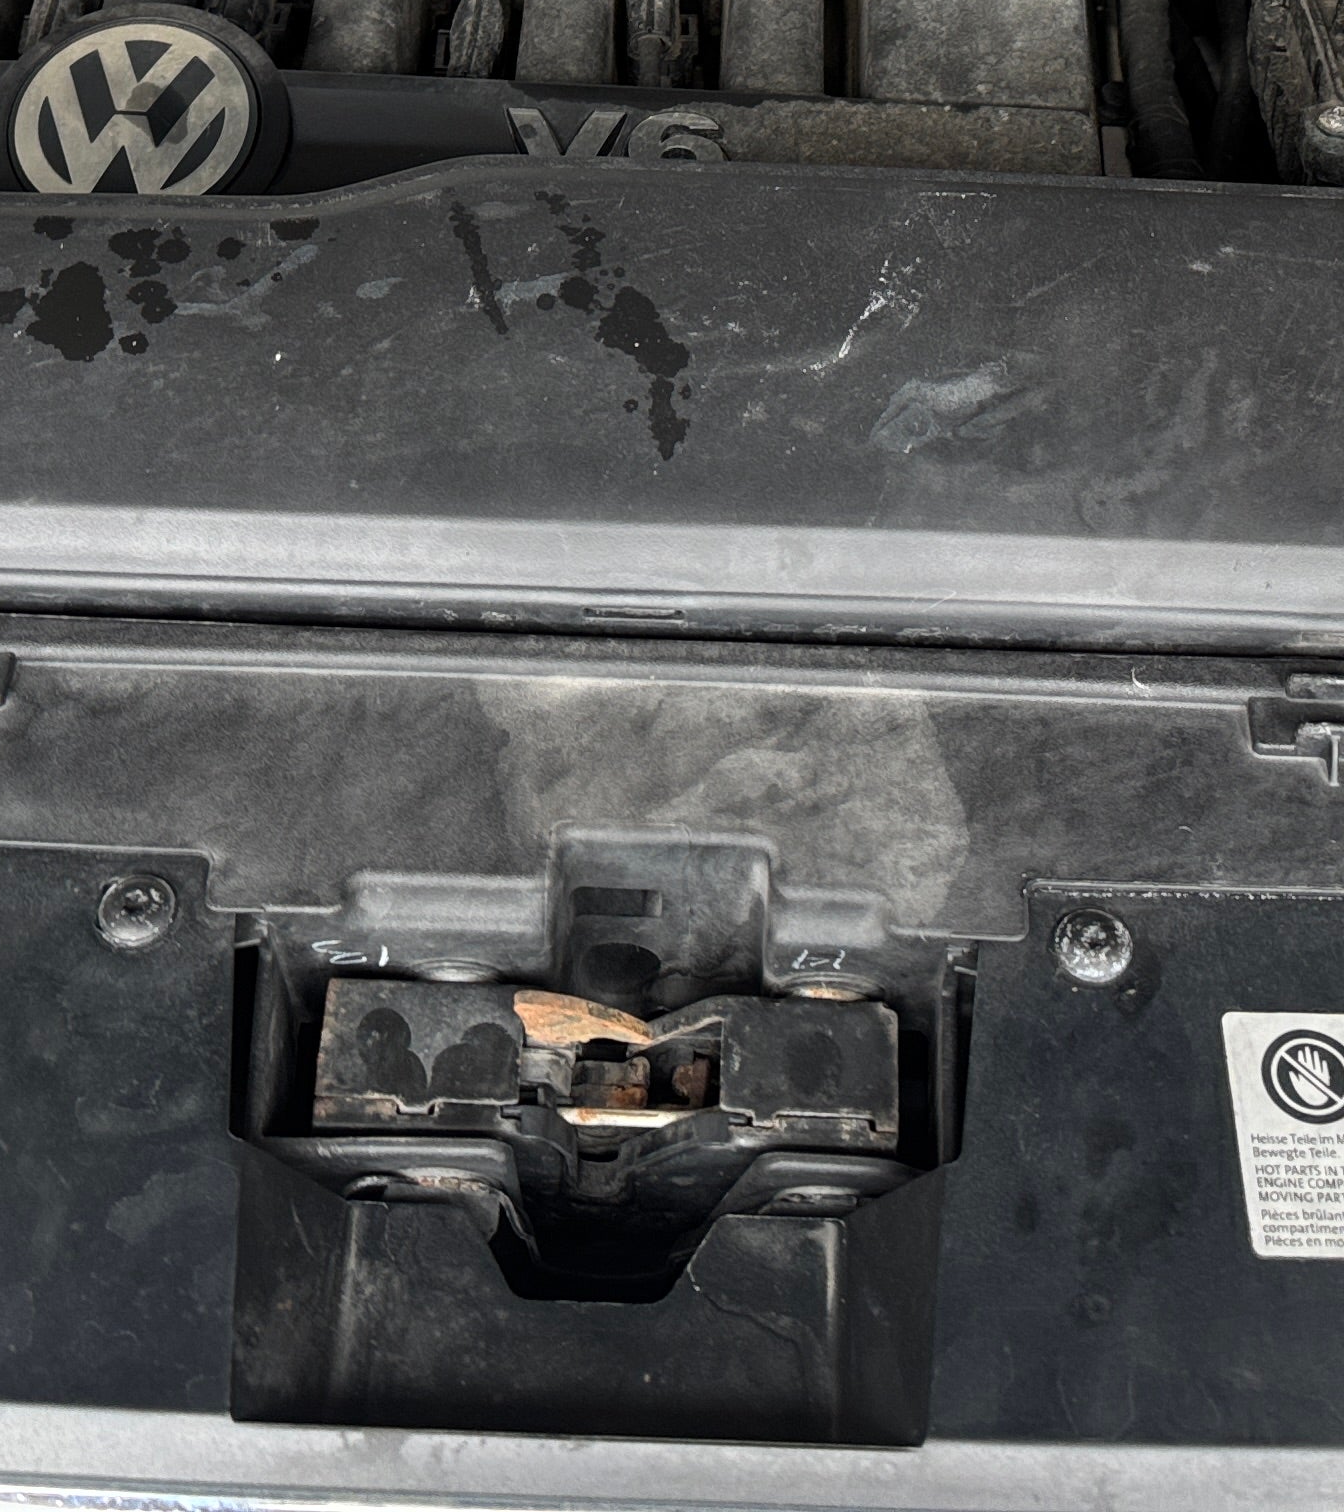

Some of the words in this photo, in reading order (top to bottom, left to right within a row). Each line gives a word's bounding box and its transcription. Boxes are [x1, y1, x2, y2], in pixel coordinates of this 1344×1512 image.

[506, 107, 728, 161] V6
[1250, 1133, 1288, 1145] Heisse
[1289, 1133, 1318, 1146] Teile
[1318, 1134, 1335, 1145] im
[1252, 1146, 1306, 1161] Bewegte
[1308, 1147, 1340, 1159] Teile.
[1254, 1164, 1281, 1176] HOT
[1284, 1164, 1322, 1176] PARTS
[1324, 1165, 1339, 1177] IN
[1256, 1176, 1304, 1189] ENGINE
[1258, 1190, 1314, 1204] MOVING
[1260, 1208, 1300, 1221] Pièces
